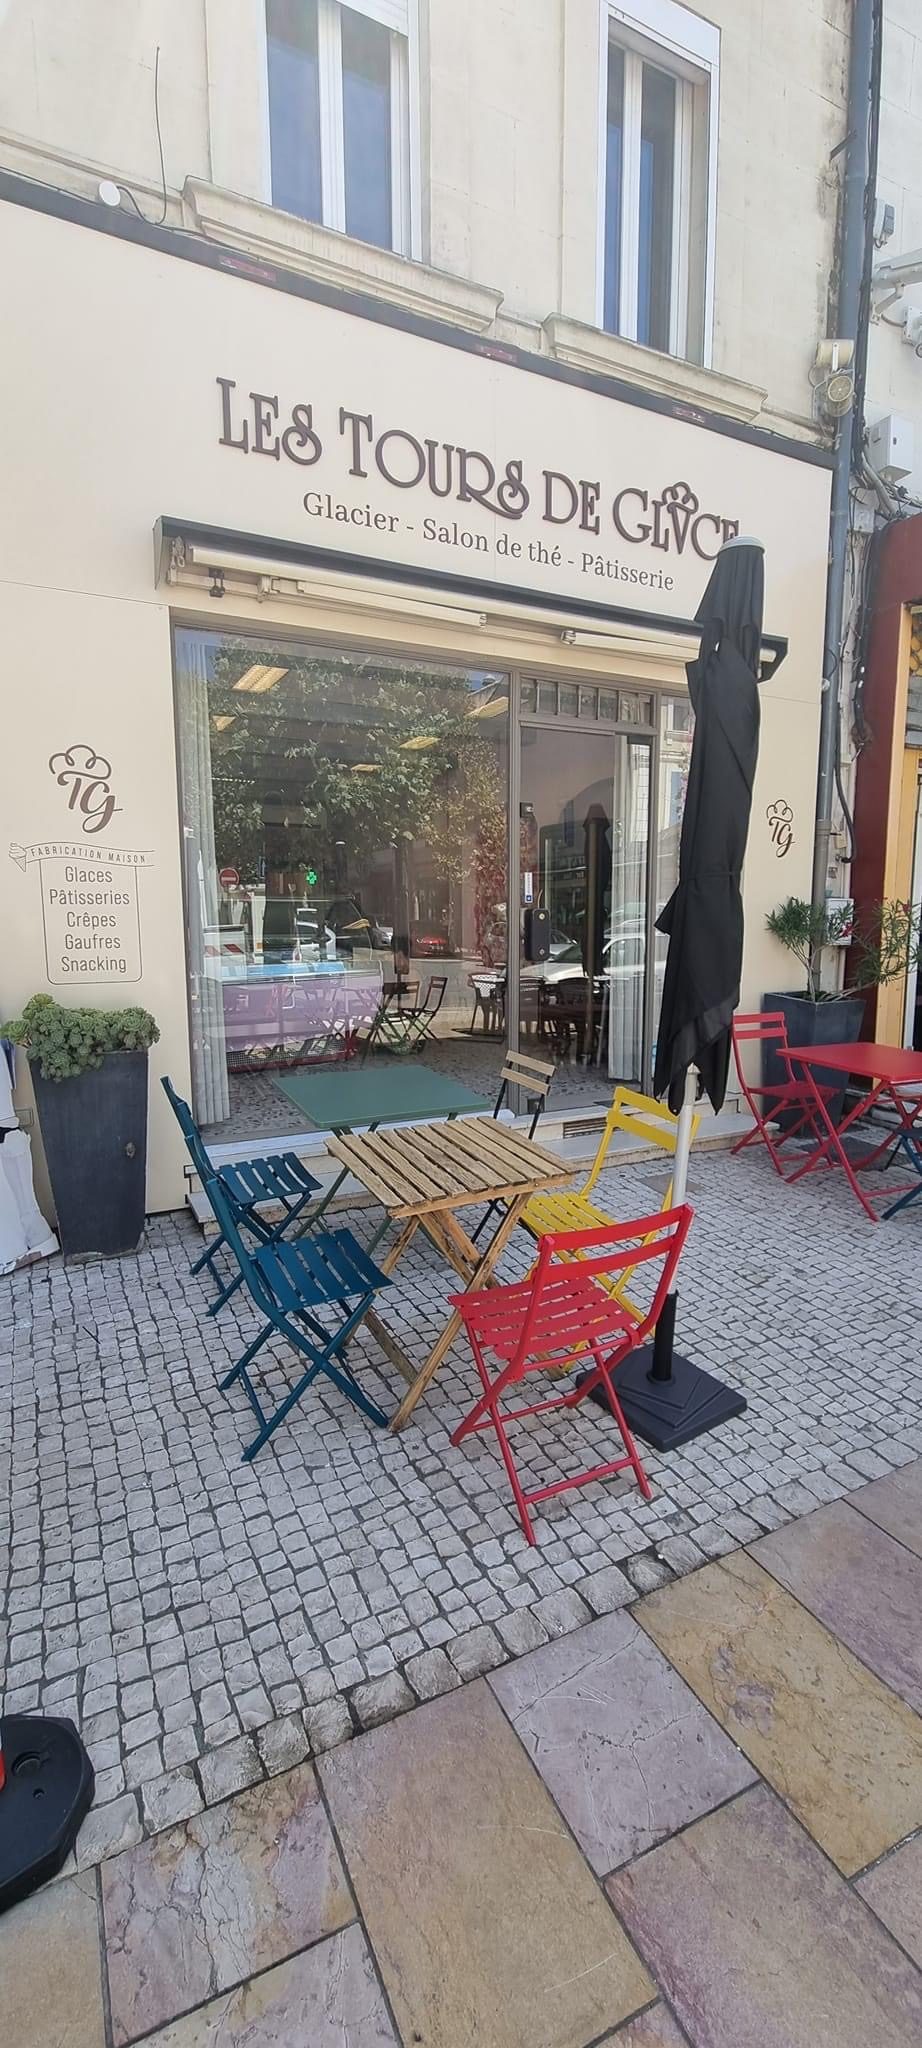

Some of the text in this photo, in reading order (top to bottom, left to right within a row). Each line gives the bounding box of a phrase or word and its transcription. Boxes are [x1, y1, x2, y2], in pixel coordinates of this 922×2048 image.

[215, 376, 323, 466] LES
[338, 406, 530, 521] TOURS
[541, 470, 601, 536] DE
[303, 492, 400, 533] Glacier
[423, 518, 490, 554] Salon
[496, 533, 522, 560] de
[527, 543, 562, 567] thé
[581, 552, 674, 591] Pâtisserie
[30, 845, 146, 864] FABRICATION MAISON
[65, 866, 113, 883] Glaces
[49, 888, 130, 905] Pâtisseries
[66, 911, 117, 930] Crêpes
[64, 933, 121, 950] Gaufres
[61, 955, 127, 974] Snacking
